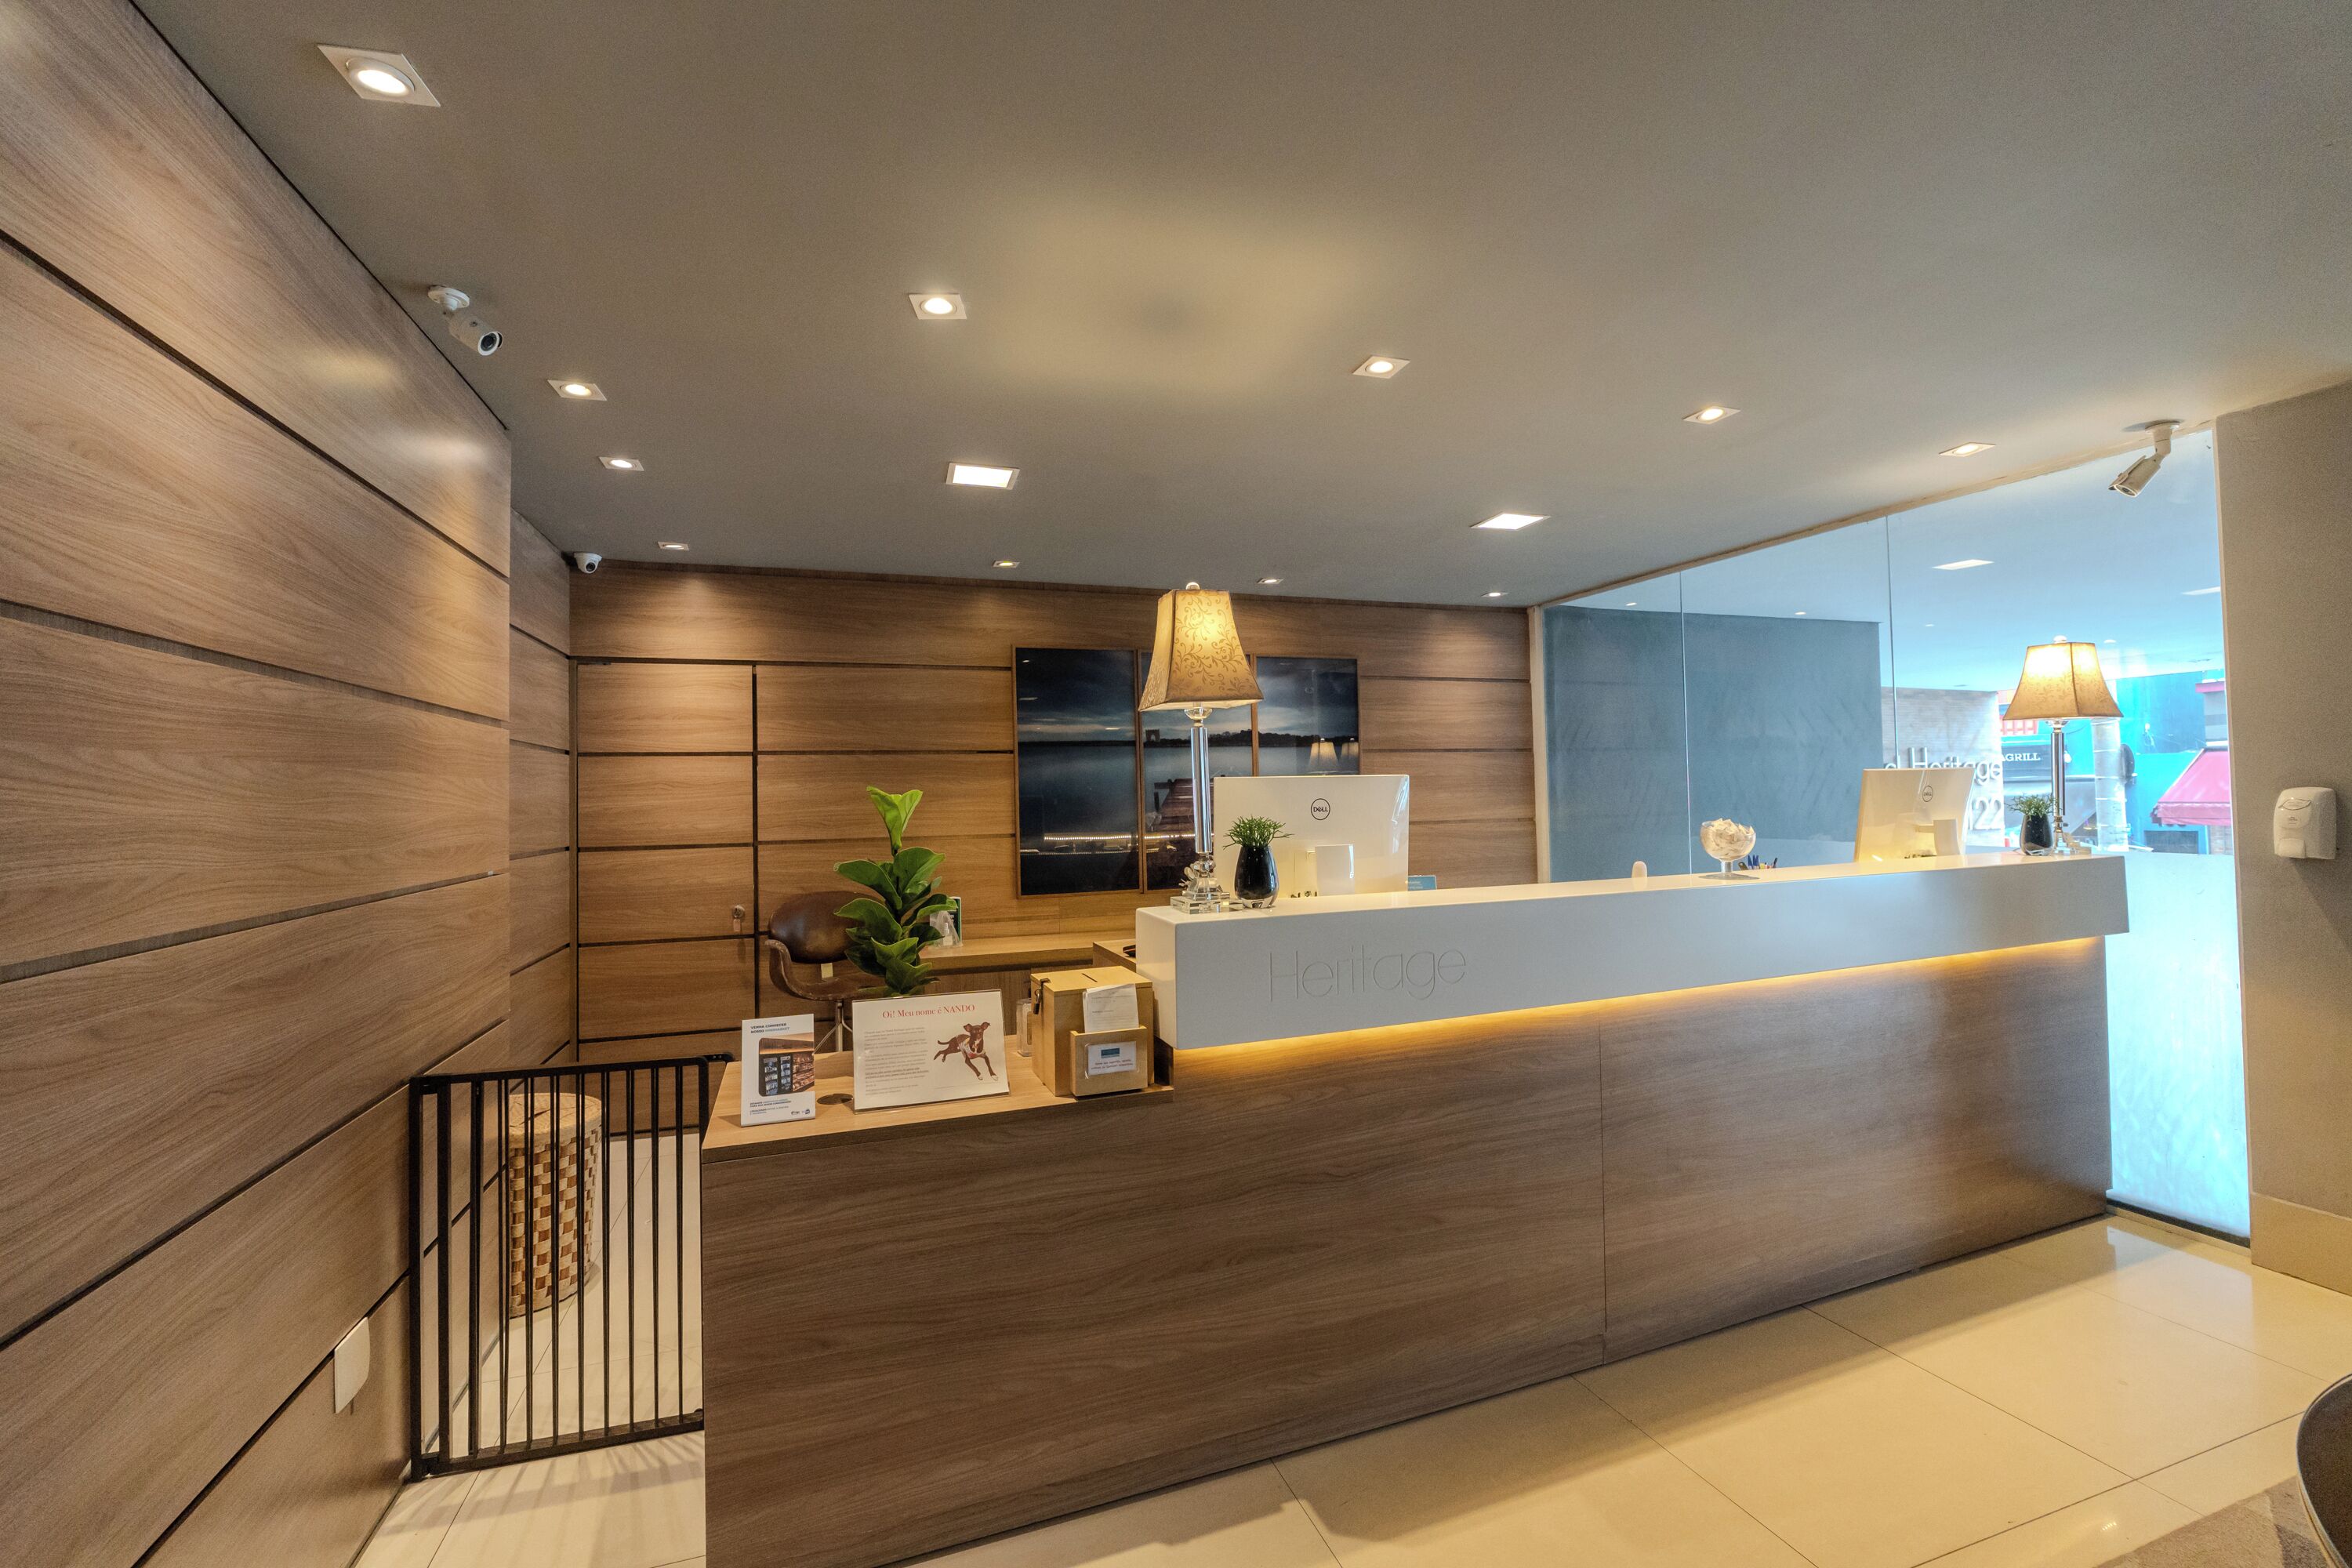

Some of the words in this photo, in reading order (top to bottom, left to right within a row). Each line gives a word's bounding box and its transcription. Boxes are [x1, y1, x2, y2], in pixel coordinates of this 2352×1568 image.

[1269, 942, 1466, 1002] Heritage
[882, 1010, 895, 1018] Oi!
[937, 1006, 942, 1014] é
[943, 1004, 975, 1013] NANDO
